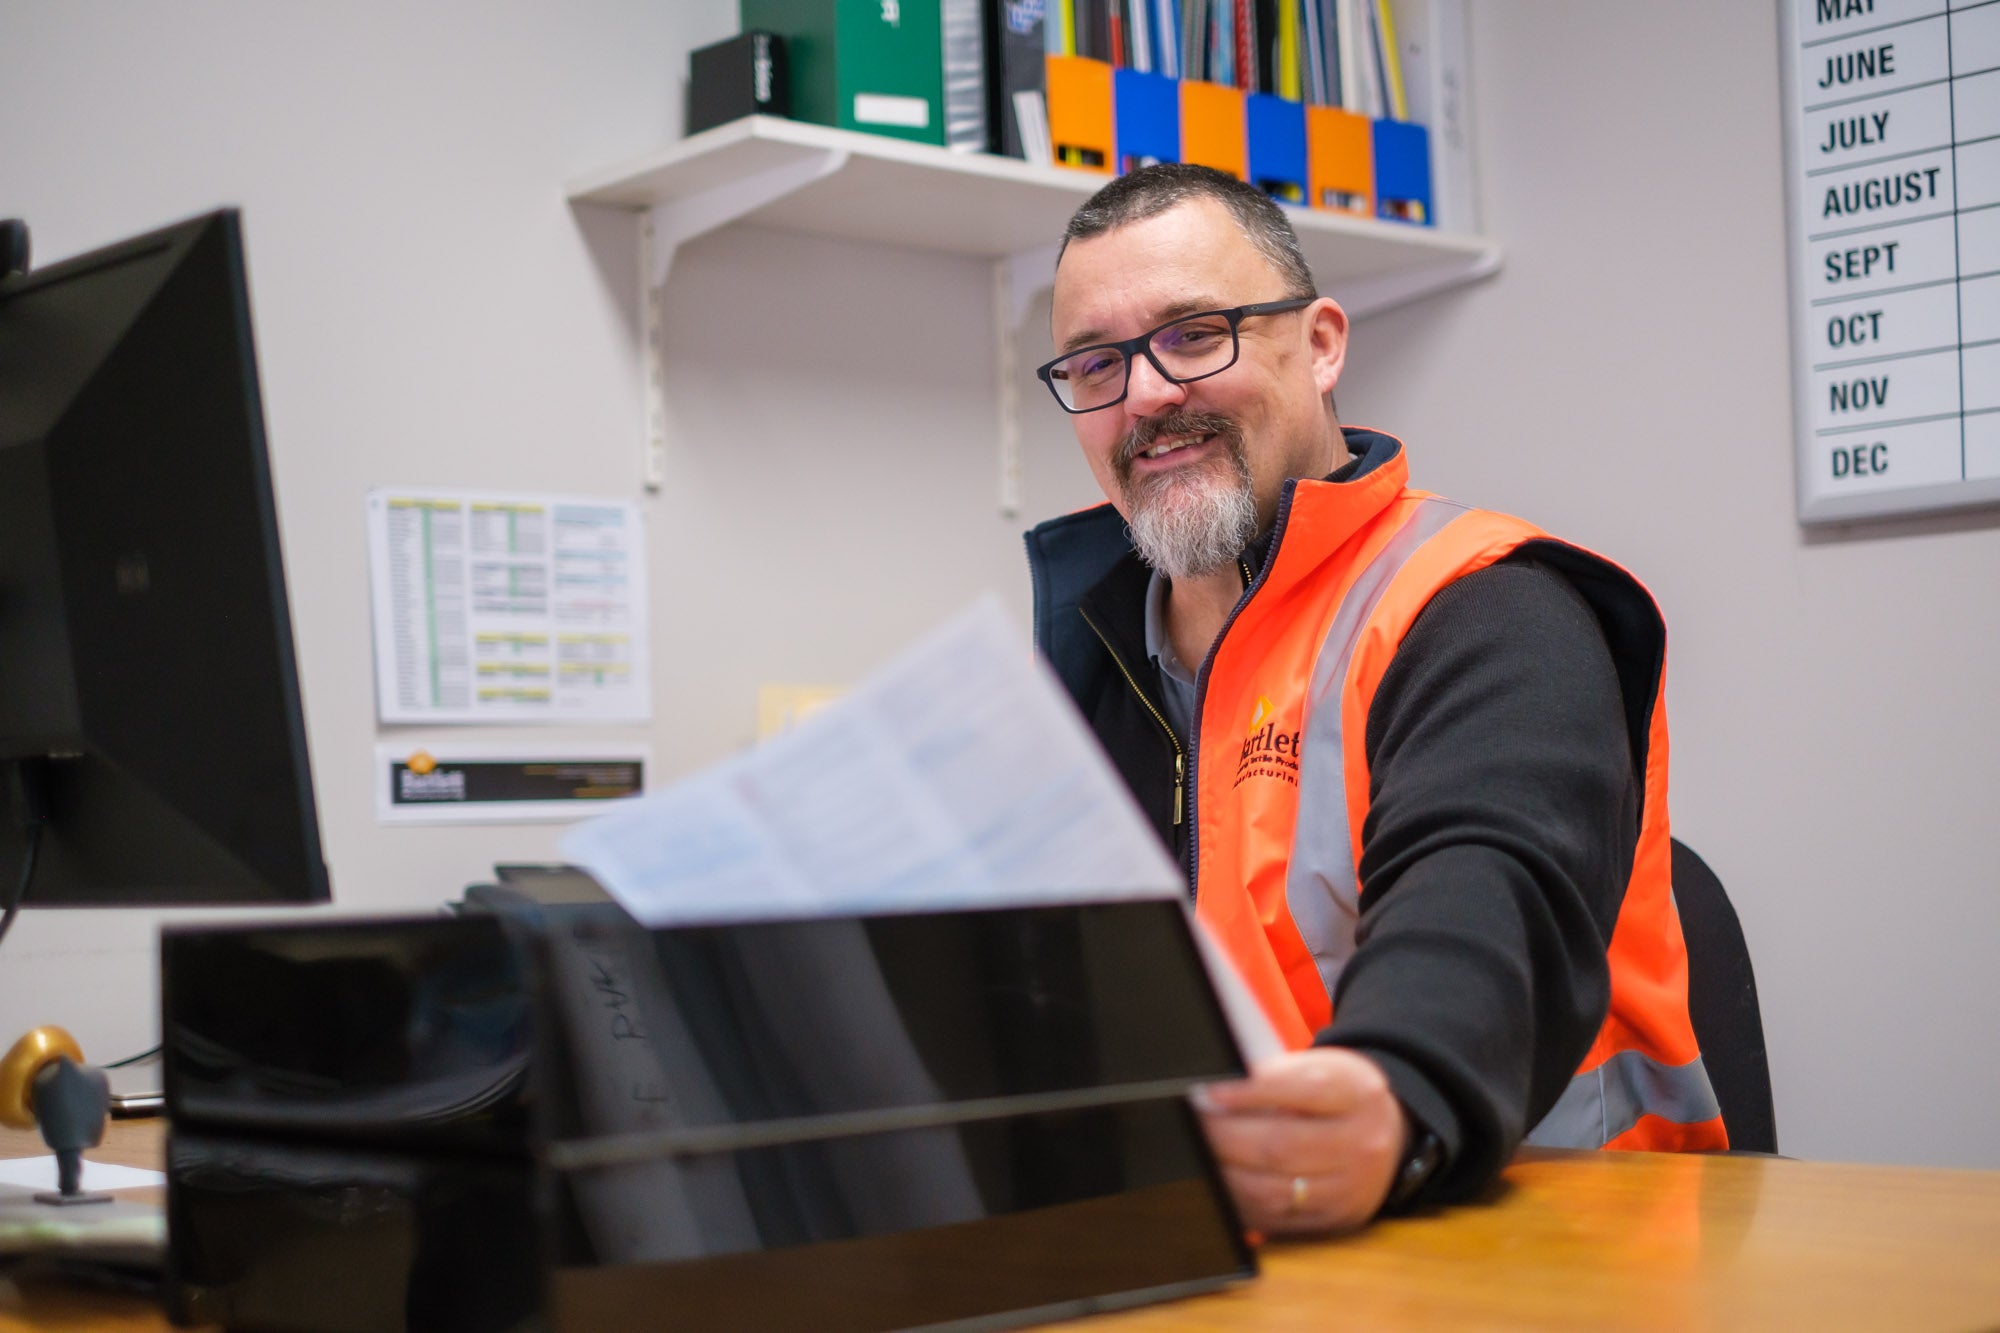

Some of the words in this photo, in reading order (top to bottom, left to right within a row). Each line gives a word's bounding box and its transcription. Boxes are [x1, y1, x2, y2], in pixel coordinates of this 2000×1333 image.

[1818, 44, 1895, 89] JUNE
[1821, 111, 1889, 153] JULY
[1823, 168, 1941, 219] AUGUST
[1825, 242, 1899, 282] SEPT
[1827, 310, 1883, 348] OCT
[1830, 375, 1889, 414] NOV
[1831, 442, 1888, 479] DEC
